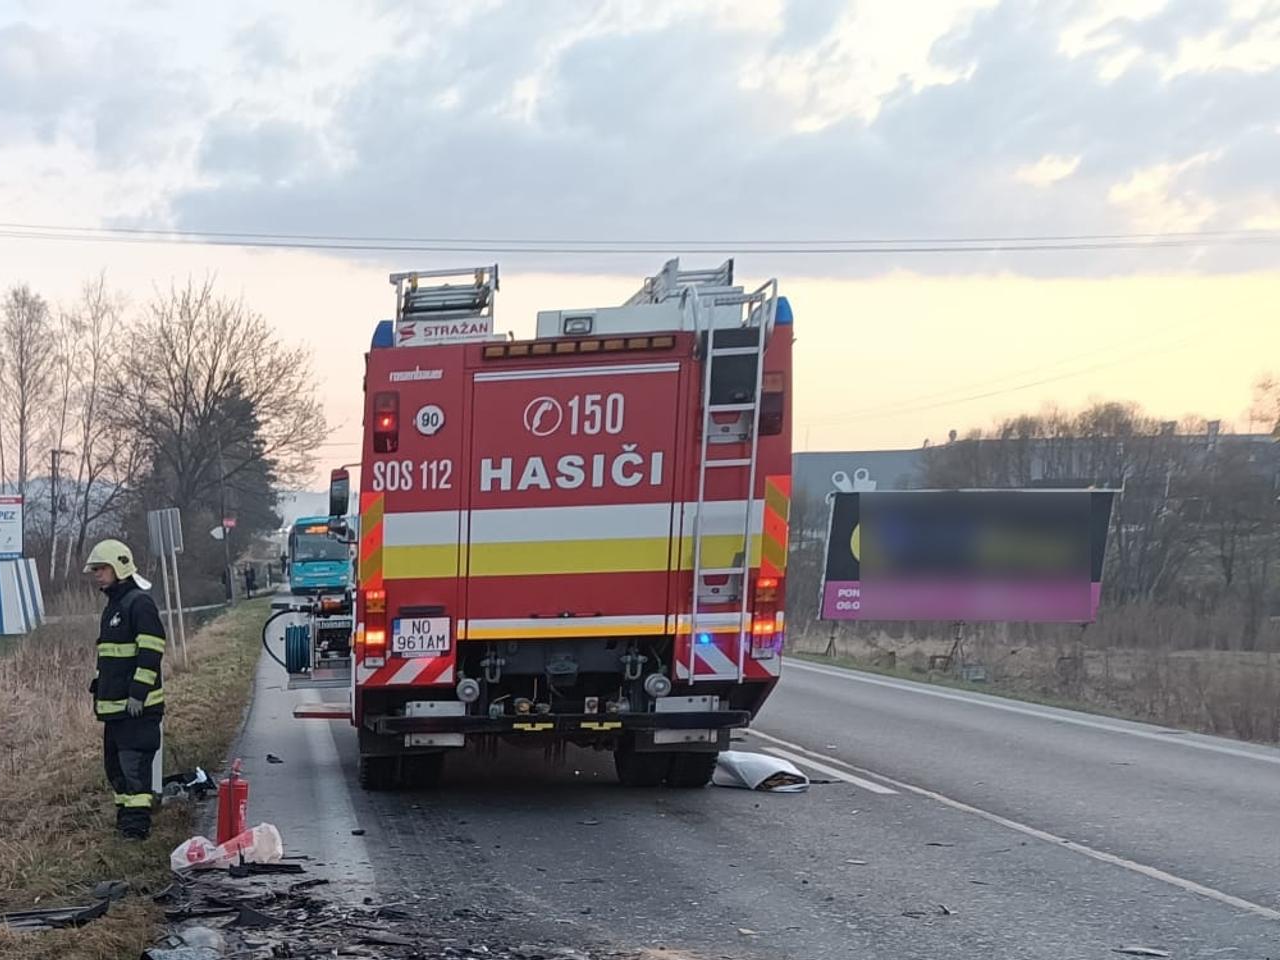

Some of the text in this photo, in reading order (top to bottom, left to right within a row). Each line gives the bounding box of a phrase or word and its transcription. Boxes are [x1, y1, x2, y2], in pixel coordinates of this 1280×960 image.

[423, 322, 488, 338] STRAŽAN
[421, 412, 439, 428] 90
[568, 393, 625, 436] 150
[480, 443, 664, 491] HASIČI
[373, 459, 452, 492] SOS 112
[412, 620, 431, 635] NO
[397, 634, 446, 650] 961AM
